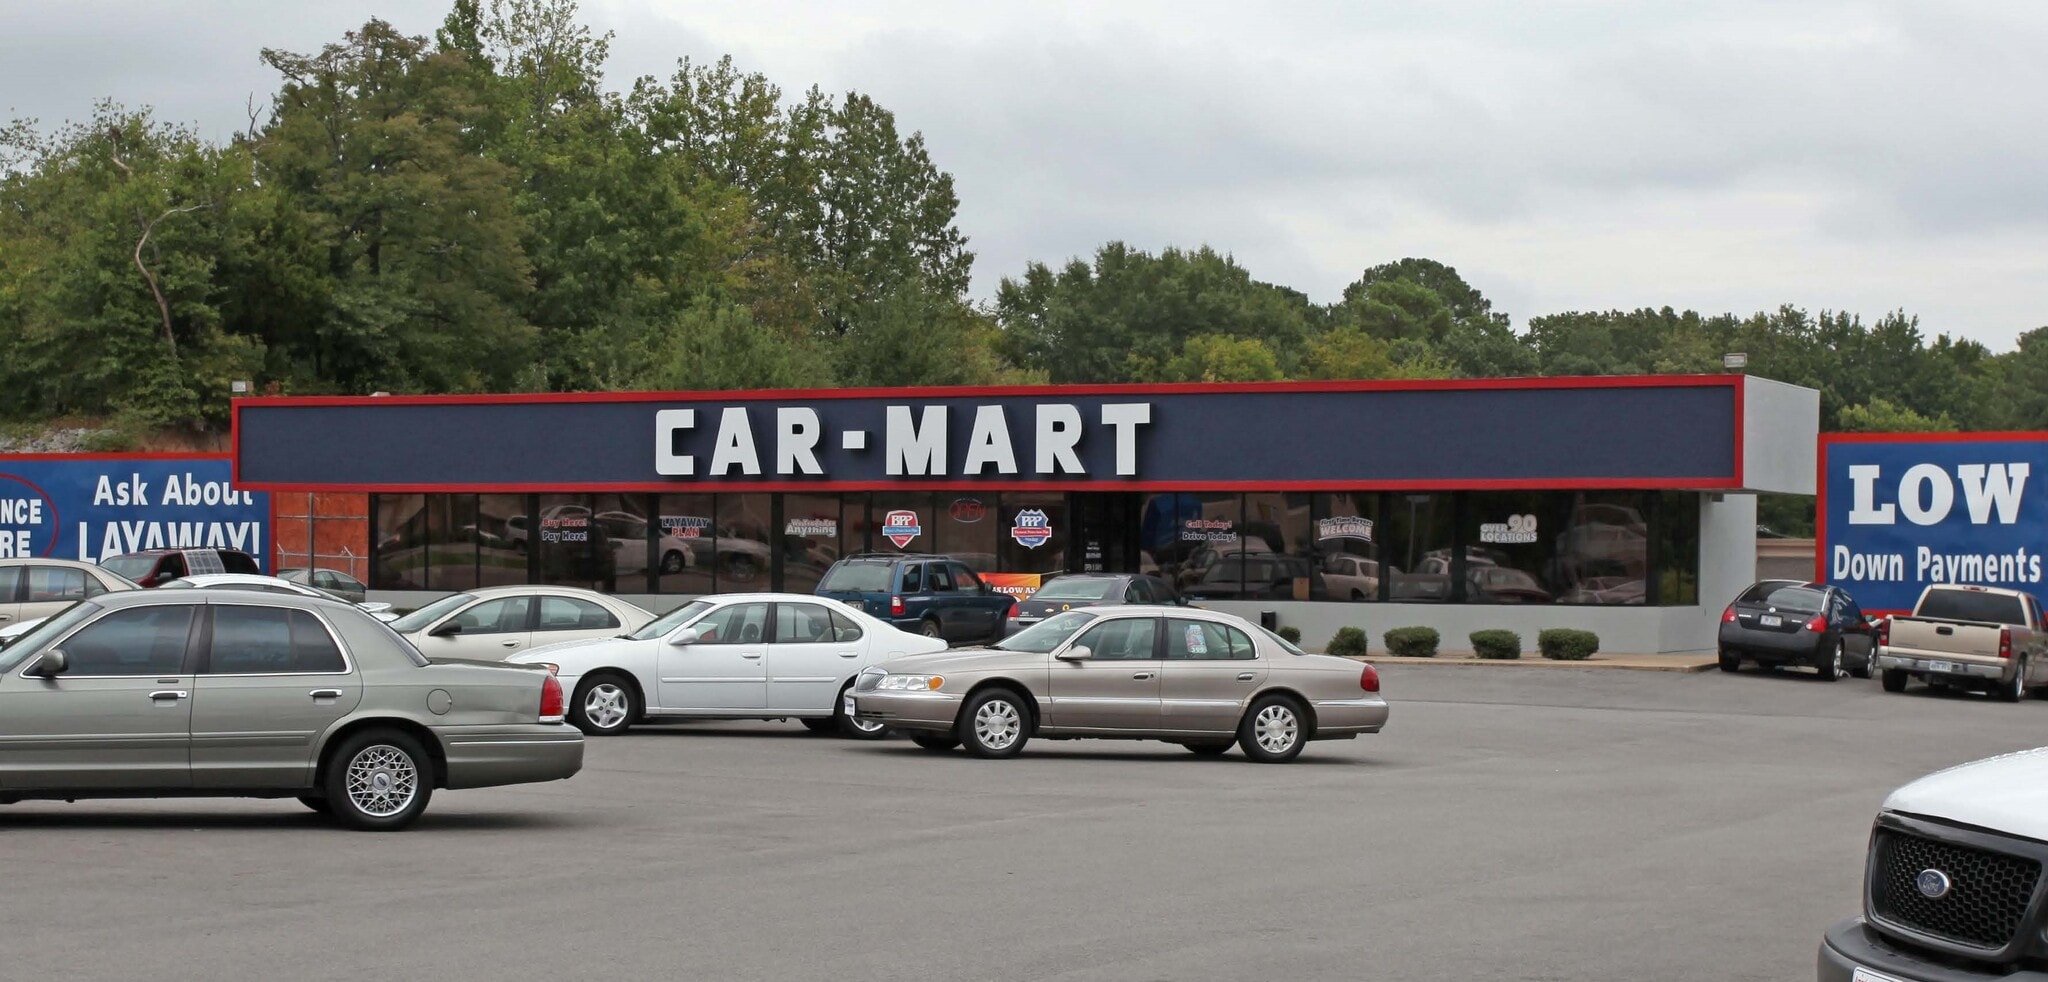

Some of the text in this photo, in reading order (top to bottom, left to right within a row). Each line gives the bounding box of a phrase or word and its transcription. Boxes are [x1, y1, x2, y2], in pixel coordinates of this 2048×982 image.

[94, 473, 148, 506] Ask
[1849, 462, 2030, 526] LOW
[543, 518, 560, 528] Buy
[662, 517, 708, 528] LAYAWAY
[891, 515, 913, 526] BPP
[1021, 515, 1042, 526] PPP
[1186, 520, 1232, 530] Call Today!
[1480, 514, 1537, 532] OVER 90
[672, 527, 699, 538] PLAN
[785, 523, 836, 537] Anything
[1320, 524, 1372, 537] WELCOME
[543, 530, 588, 543] Pay Here!
[1182, 532, 1236, 542] Drive Today!
[1480, 531, 1537, 543] LOCATIONS
[79, 520, 260, 569] LAYAWAY!
[1834, 545, 2041, 585] Down Payments
[1003, 586, 1023, 594] LOW
[1025, 586, 1036, 594] AS
